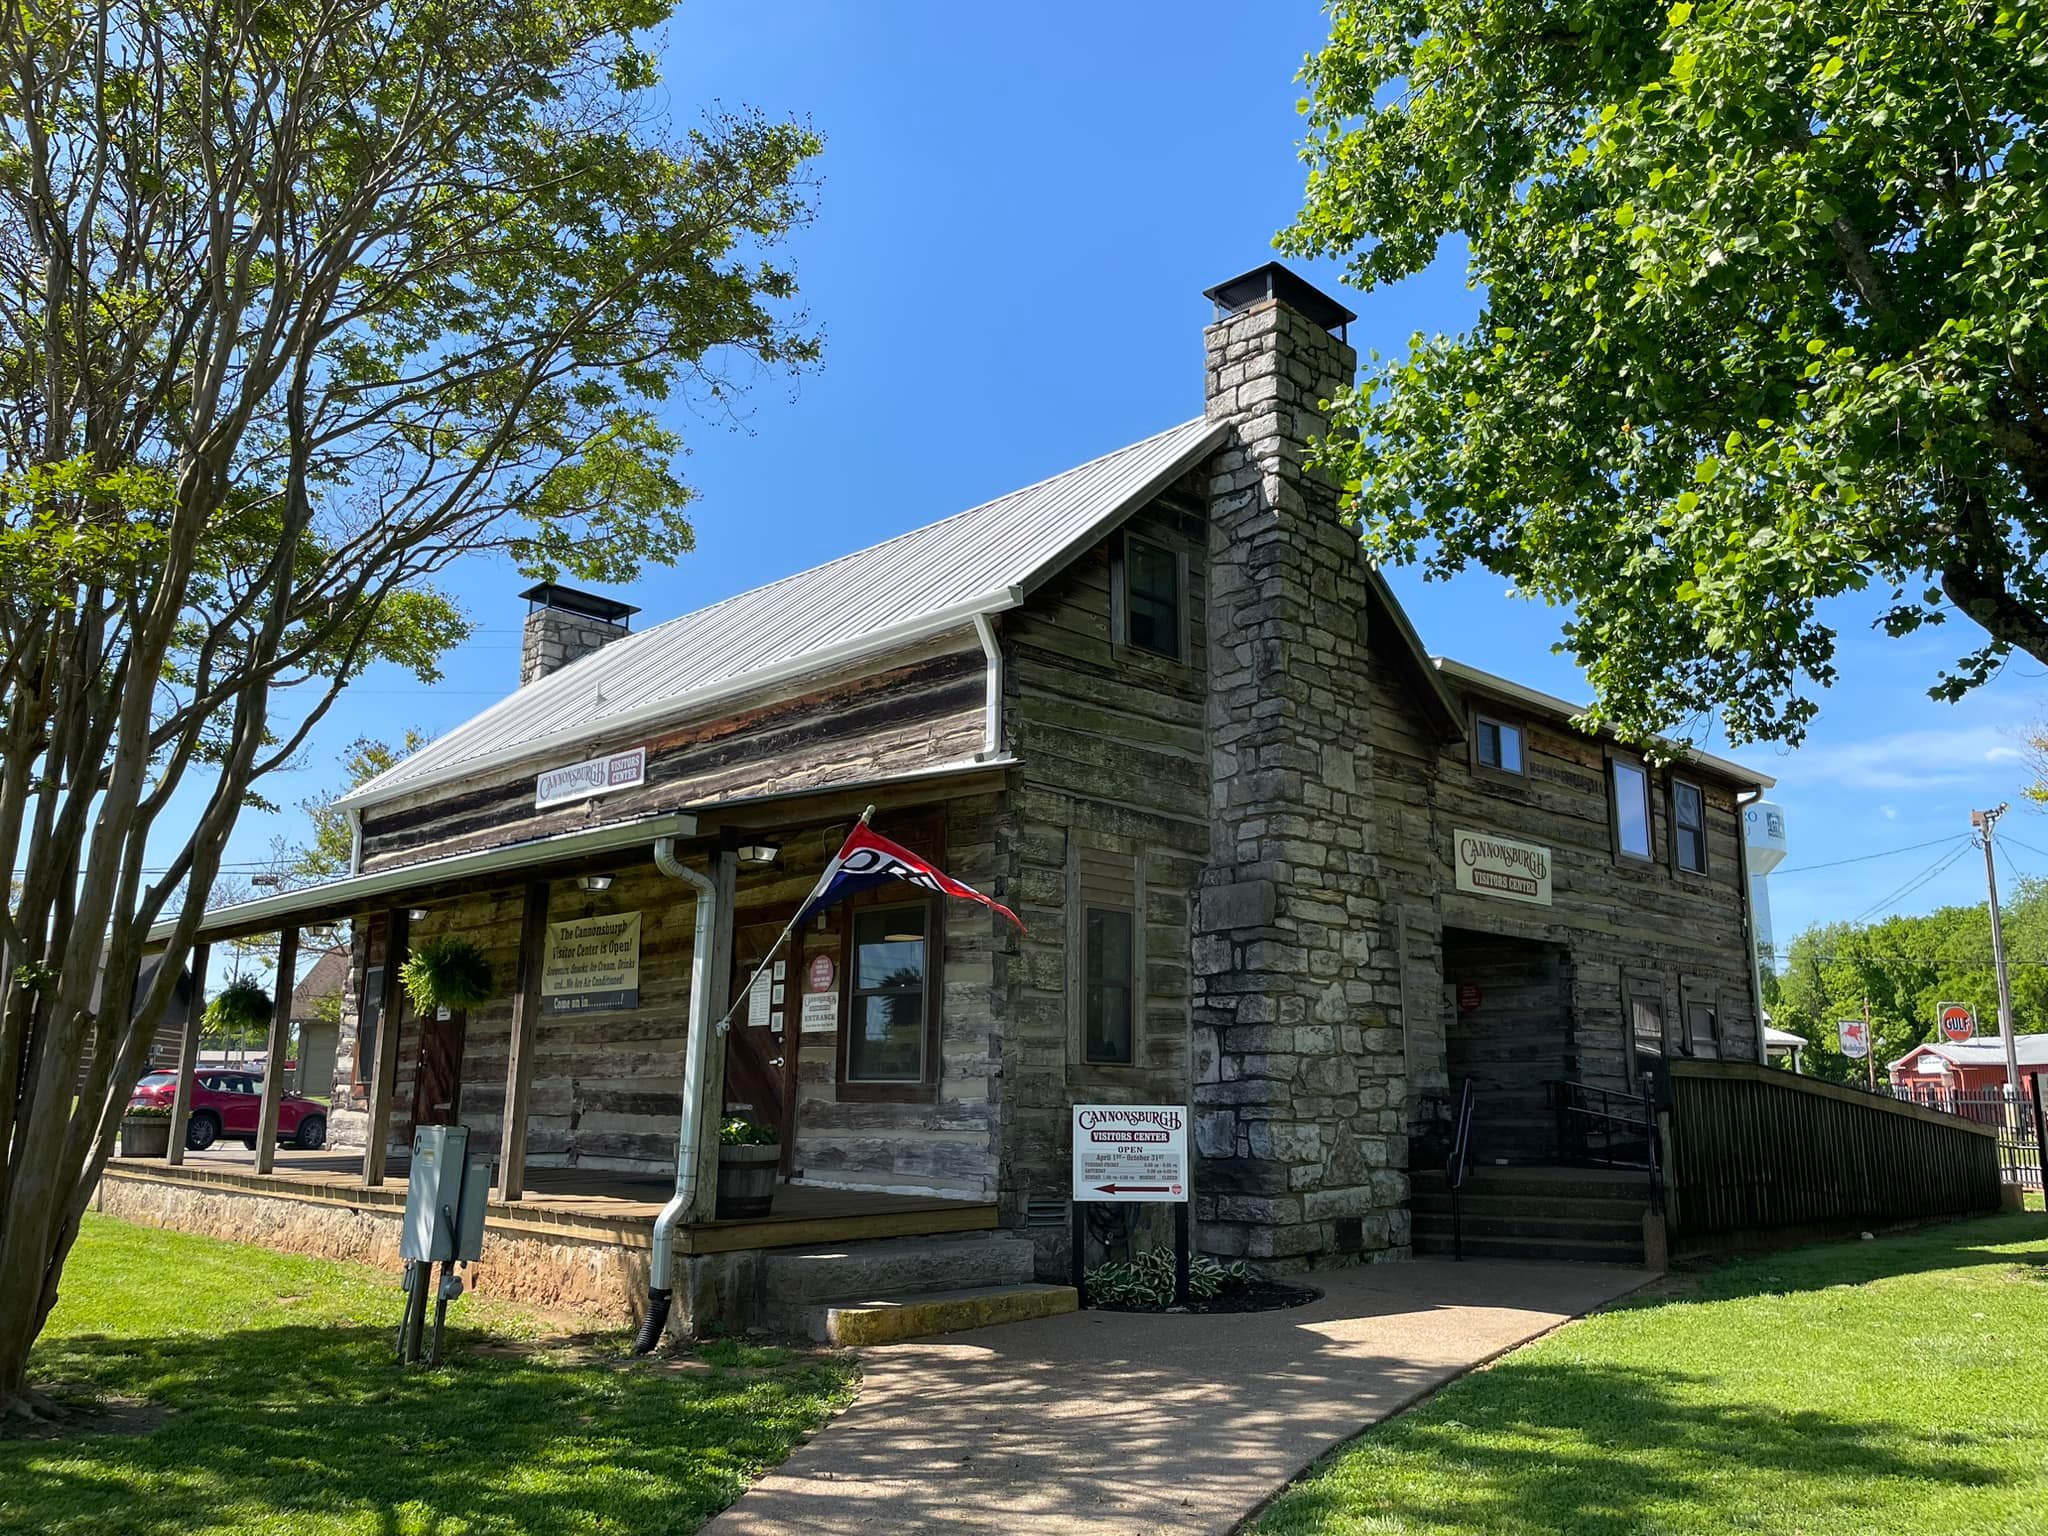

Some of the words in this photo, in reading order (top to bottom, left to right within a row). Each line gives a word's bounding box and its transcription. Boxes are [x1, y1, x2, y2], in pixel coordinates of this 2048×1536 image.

[611, 755, 639, 771] VISITORS
[541, 762, 606, 799] CANNONSBURGH
[611, 768, 637, 783] CENTER
[1461, 838, 1547, 879] CANNONSBURGH
[1475, 871, 1508, 889] VISITORS
[1508, 878, 1537, 893] CENTER
[560, 928, 573, 940] The
[574, 920, 628, 939] Cannonsburgh
[552, 946, 576, 960] Visitor
[576, 943, 599, 957] Center
[600, 942, 607, 954] is
[608, 938, 633, 956] Open!
[554, 997, 570, 1009] Come
[1945, 1016, 1970, 1032] GULF
[1079, 1110, 1182, 1131] CANNONSBURGH
[1093, 1132, 1132, 1141] VISITORS
[1134, 1132, 1167, 1141] CENTER
